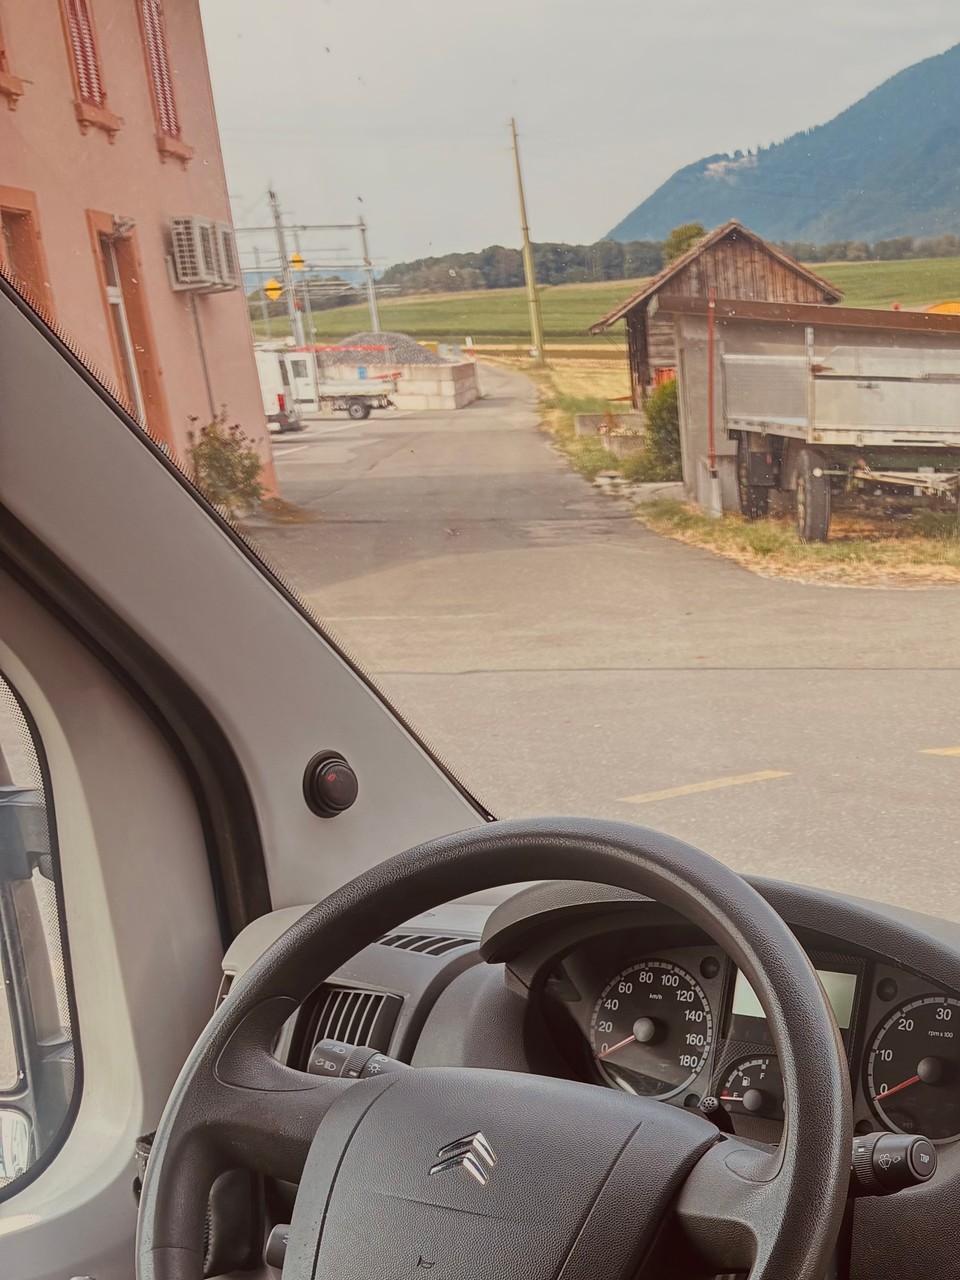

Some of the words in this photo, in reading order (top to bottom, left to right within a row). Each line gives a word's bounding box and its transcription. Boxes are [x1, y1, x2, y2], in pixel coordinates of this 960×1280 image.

[639, 971, 653, 984] 80
[661, 974, 679, 987] 100
[618, 982, 633, 994] 60
[676, 990, 694, 1002] 120
[604, 999, 619, 1010] 40
[684, 1010, 703, 1022] 140
[936, 1008, 952, 1020] 30
[598, 1021, 613, 1032] 20
[898, 1019, 914, 1031] 20
[685, 1033, 704, 1046] 160
[601, 1043, 609, 1053] 0
[679, 1055, 698, 1067] 180
[880, 1049, 893, 1061] 10
[880, 1083, 888, 1094] 0
